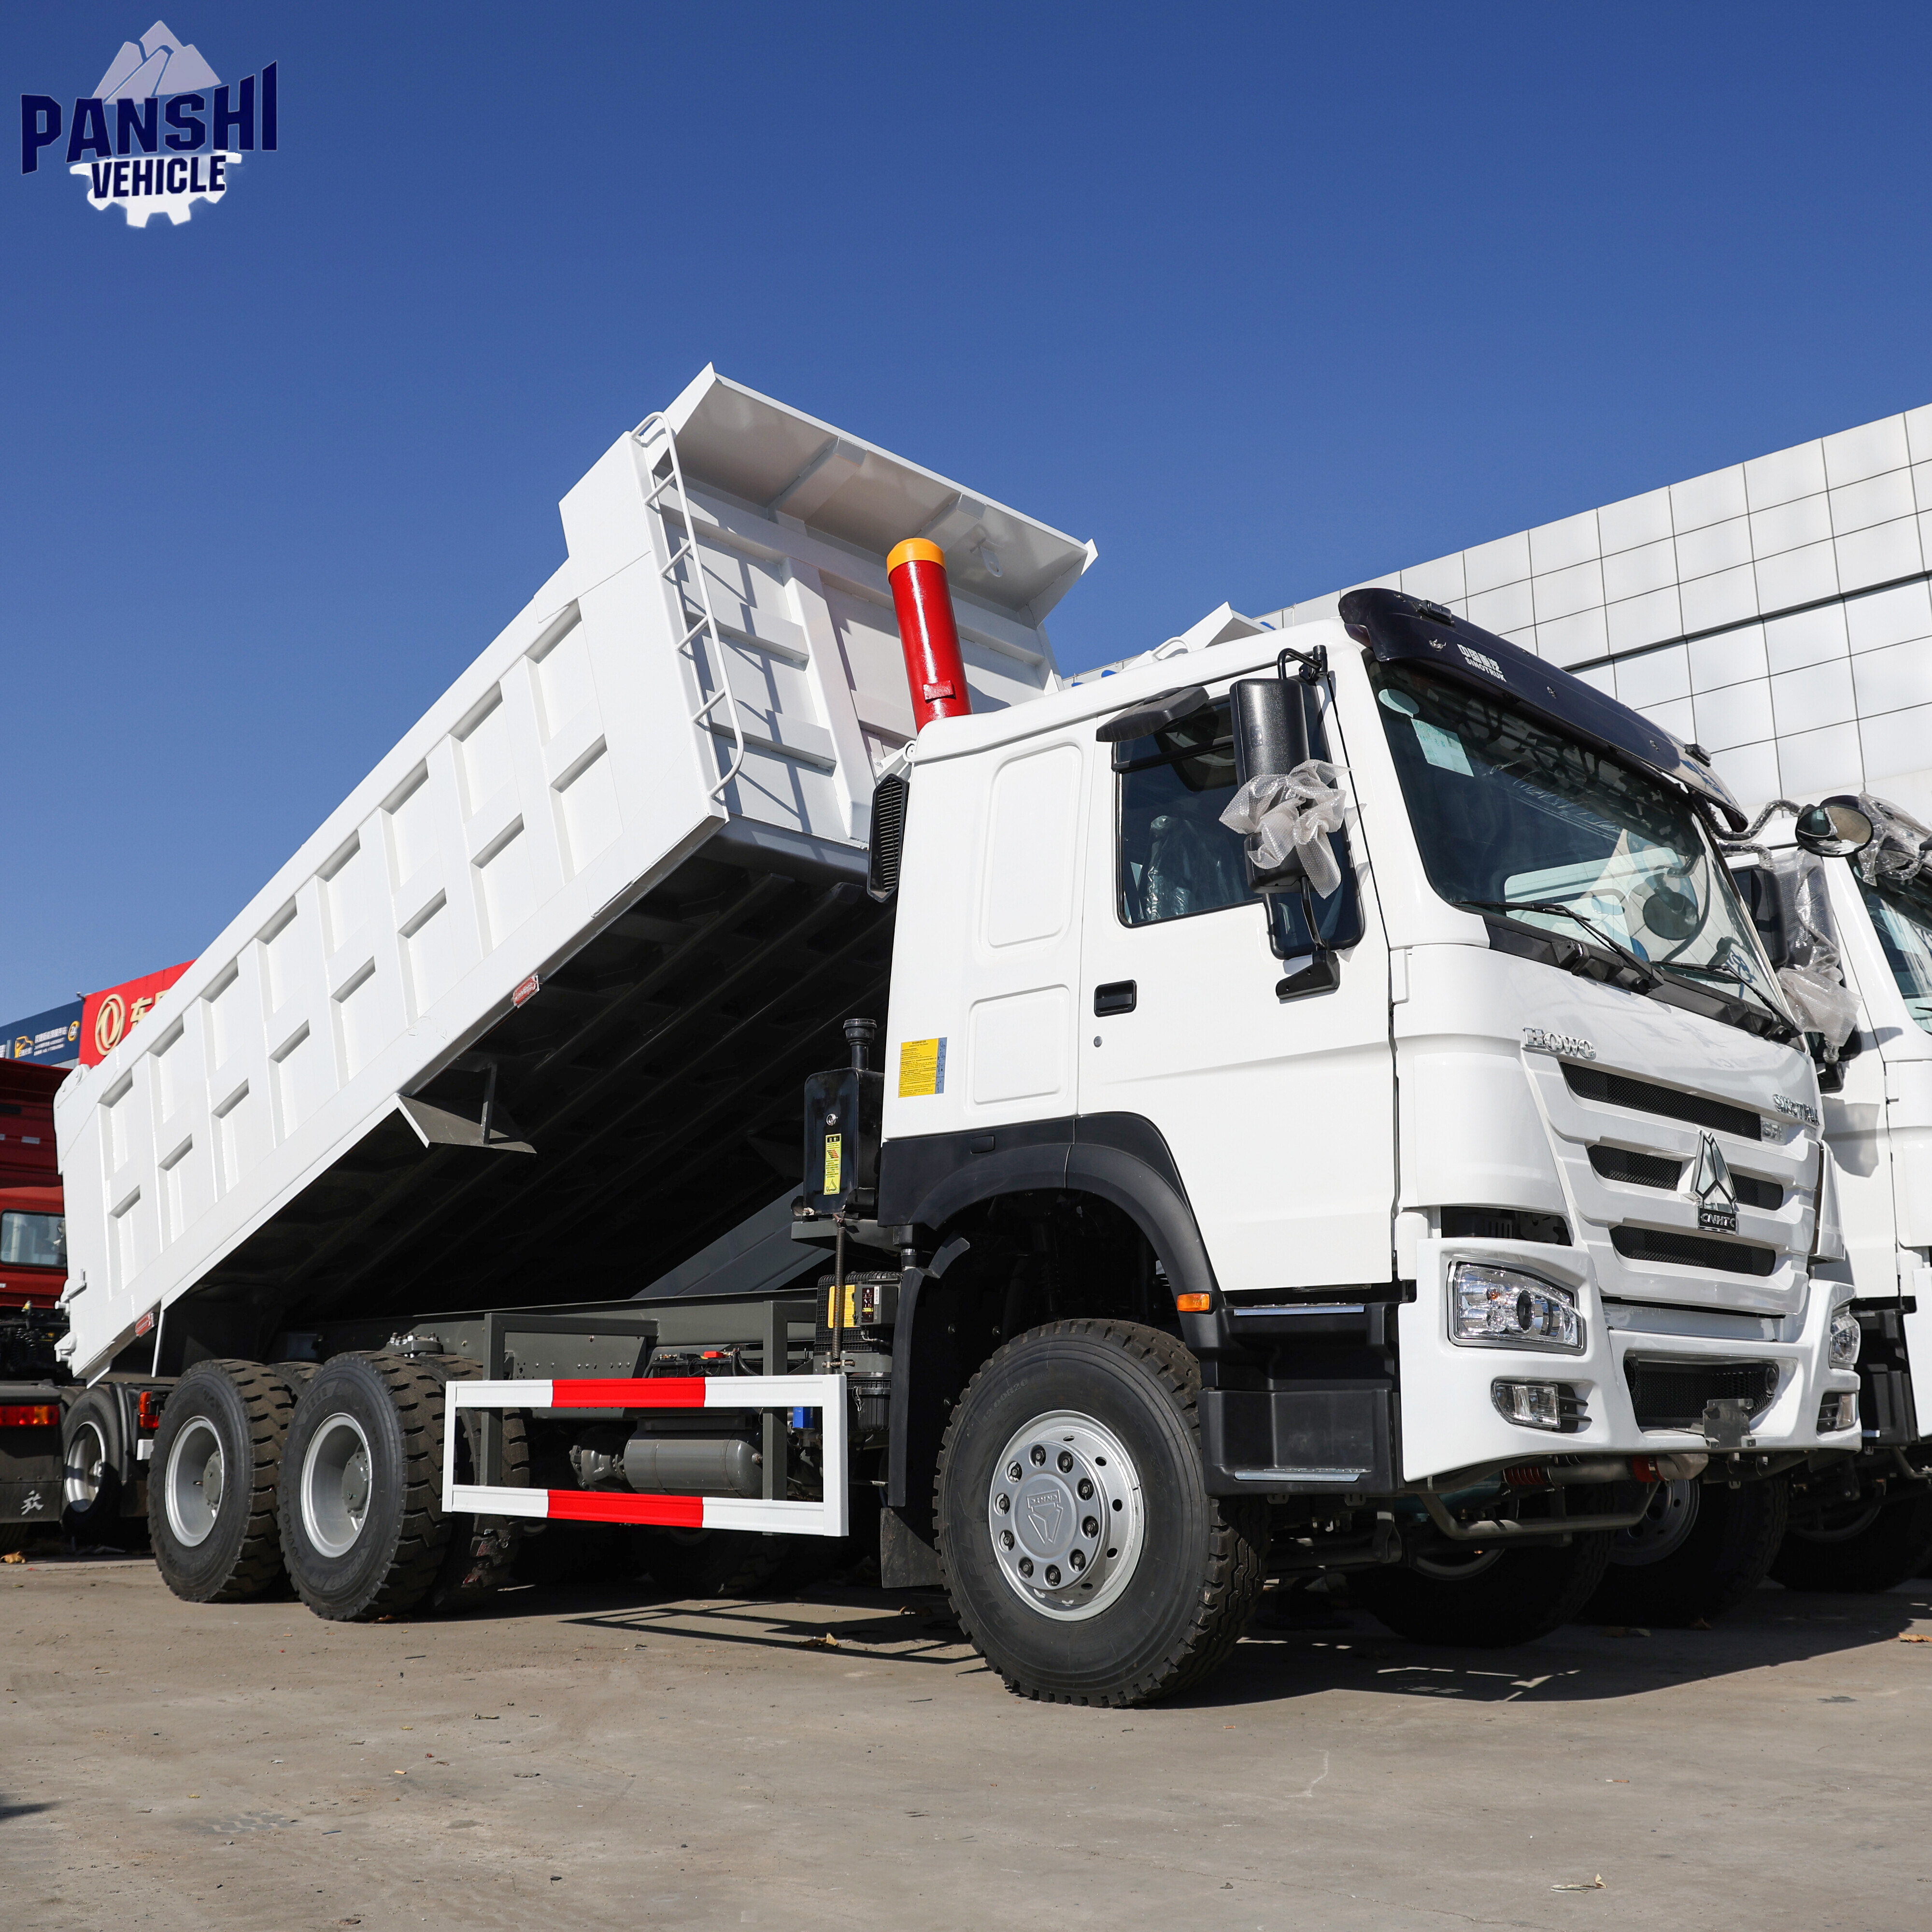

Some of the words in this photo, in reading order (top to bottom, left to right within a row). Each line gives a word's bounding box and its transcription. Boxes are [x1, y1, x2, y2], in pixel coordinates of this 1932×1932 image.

[1457, 643, 1503, 674] 中国重汽
[1465, 657, 1507, 682] SINOTRUK
[1522, 1027, 1596, 1059] HOWO
[1773, 1094, 1819, 1125] SINOTRUK
[1700, 1213, 1736, 1228] CNHTC
